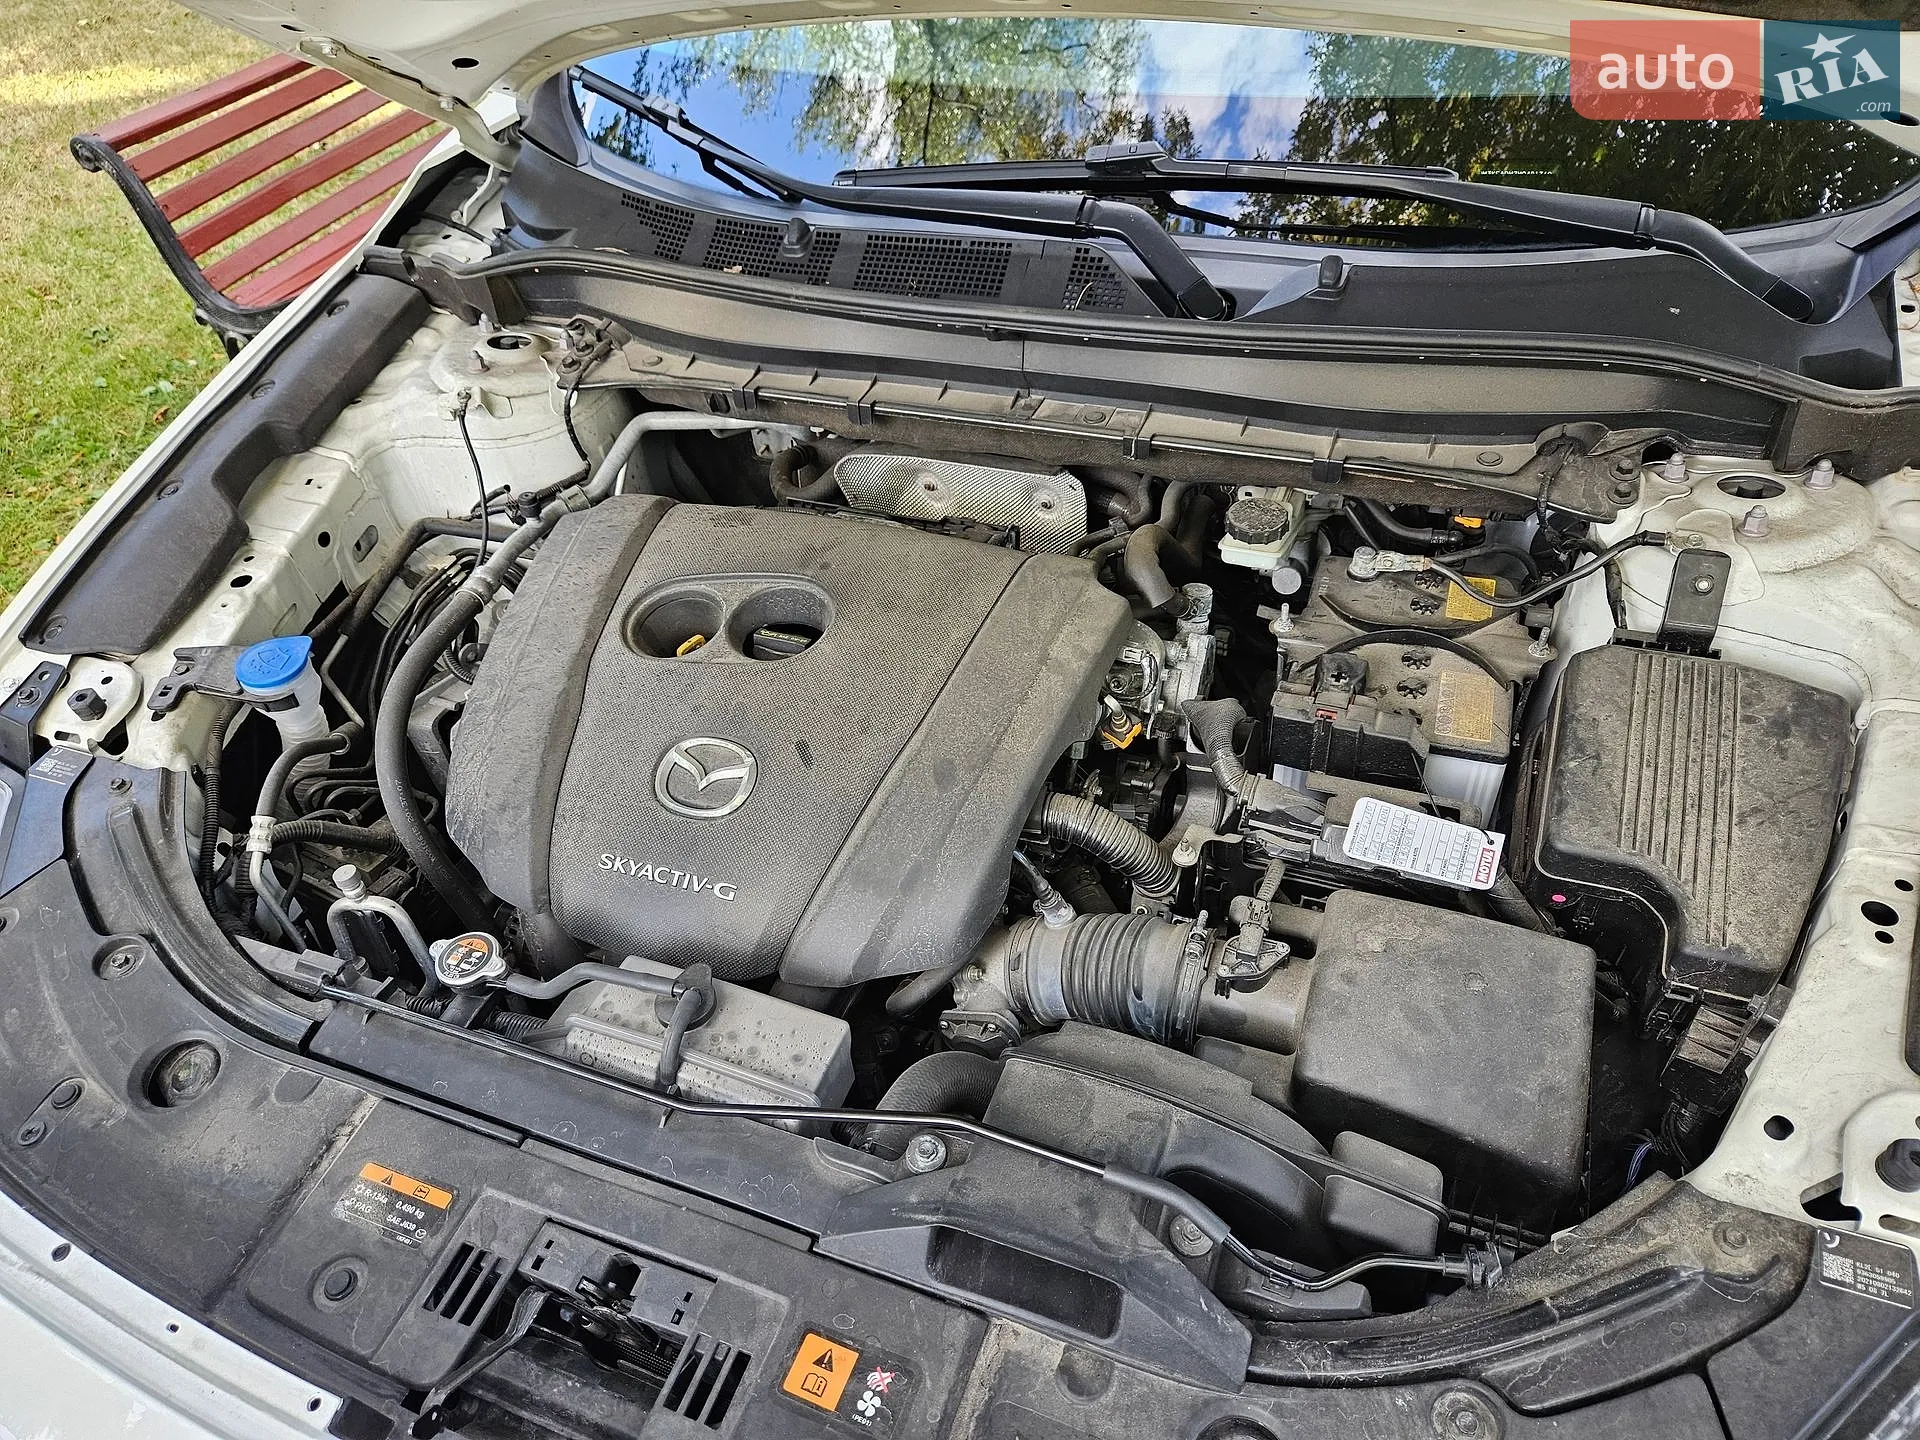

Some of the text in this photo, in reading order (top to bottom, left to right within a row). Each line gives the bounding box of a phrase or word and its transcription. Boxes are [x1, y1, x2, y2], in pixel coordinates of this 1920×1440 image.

[598, 853, 738, 901] SKYACTIV-G
[1476, 849, 1494, 884] MOTUL
[355, 1201, 372, 1213] PAG
[386, 1214, 401, 1224] SAE
[395, 1200, 416, 1214] 0.490
[414, 1208, 425, 1219] kg
